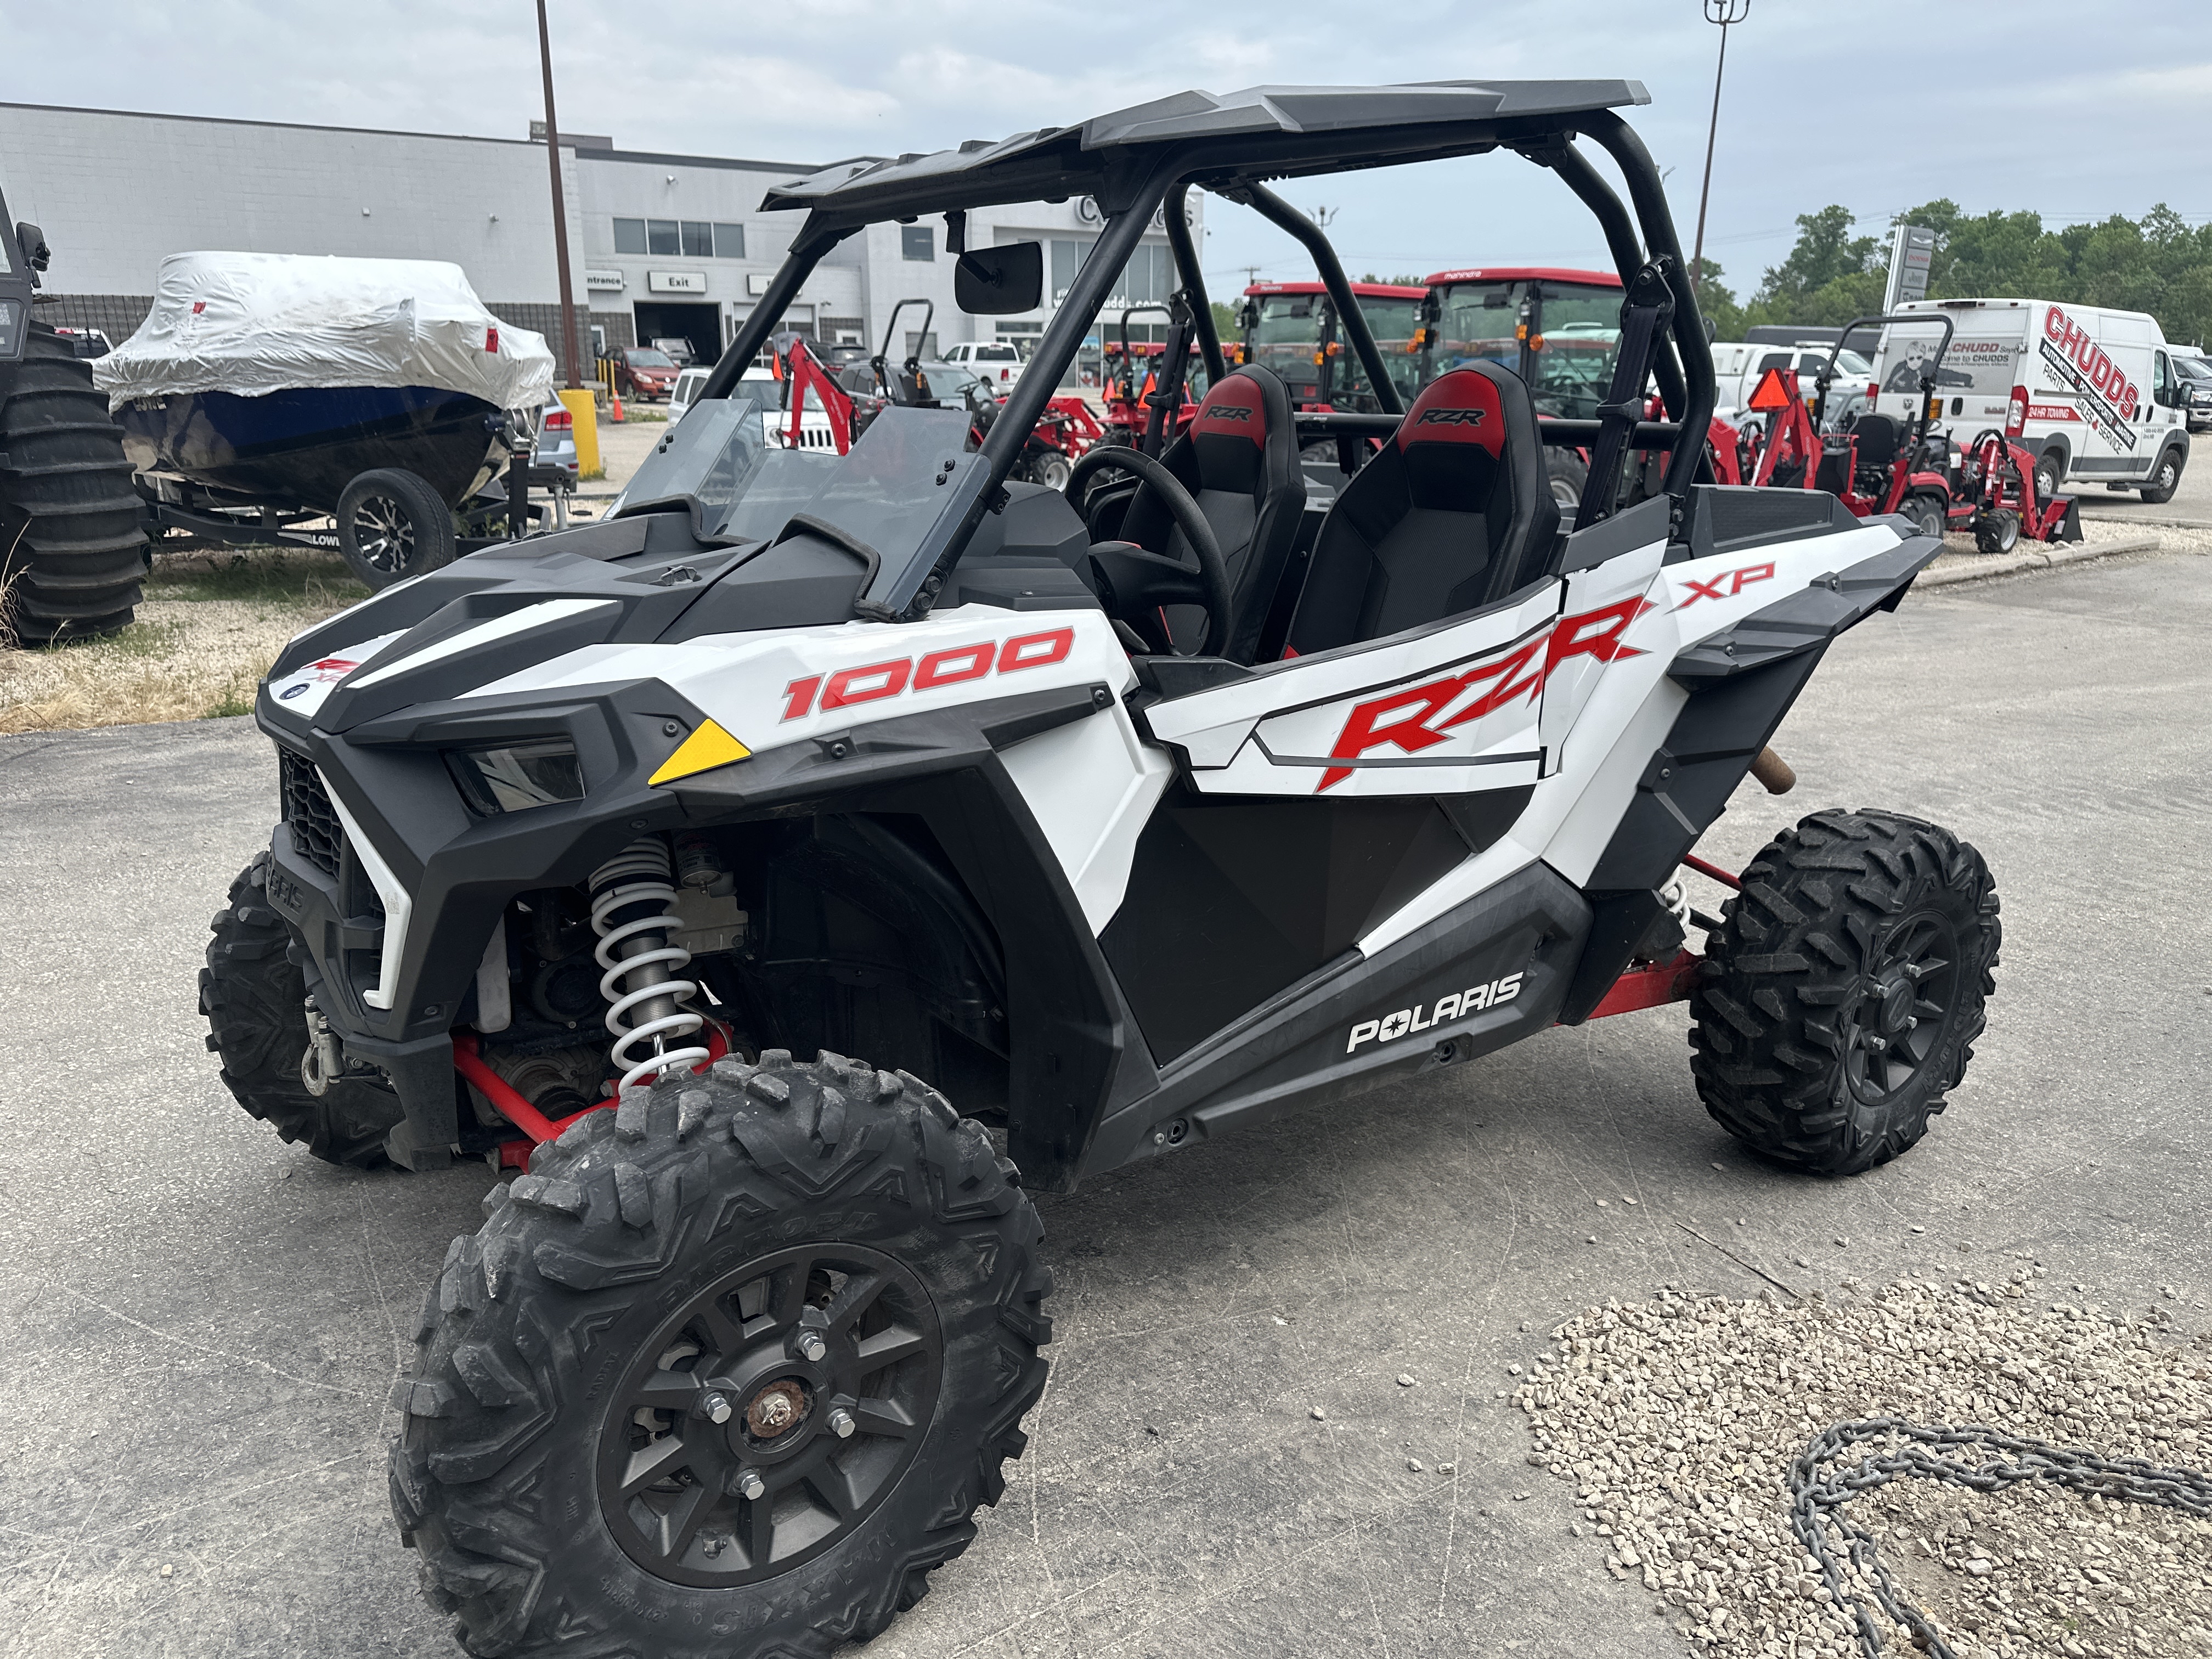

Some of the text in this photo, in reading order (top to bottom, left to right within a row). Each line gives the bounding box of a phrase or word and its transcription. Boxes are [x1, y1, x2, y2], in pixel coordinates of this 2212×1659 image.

[669, 276, 689, 287] Exit
[1953, 342, 2000, 353] CHUDD
[2044, 304, 2139, 421] CHUDDS
[2043, 363, 2066, 392] PARTS
[1203, 405, 1254, 422] RZR
[1414, 408, 1487, 427] RZR
[2028, 407, 2069, 419] 24 HR TOWING
[2075, 397, 2123, 455] SALES SERVICE
[312, 534, 341, 546] LOW
[1664, 561, 1776, 614] XP
[778, 625, 1076, 725] 1000
[1314, 593, 1659, 794] RZR
[1346, 971, 1524, 1054] POLARIS
